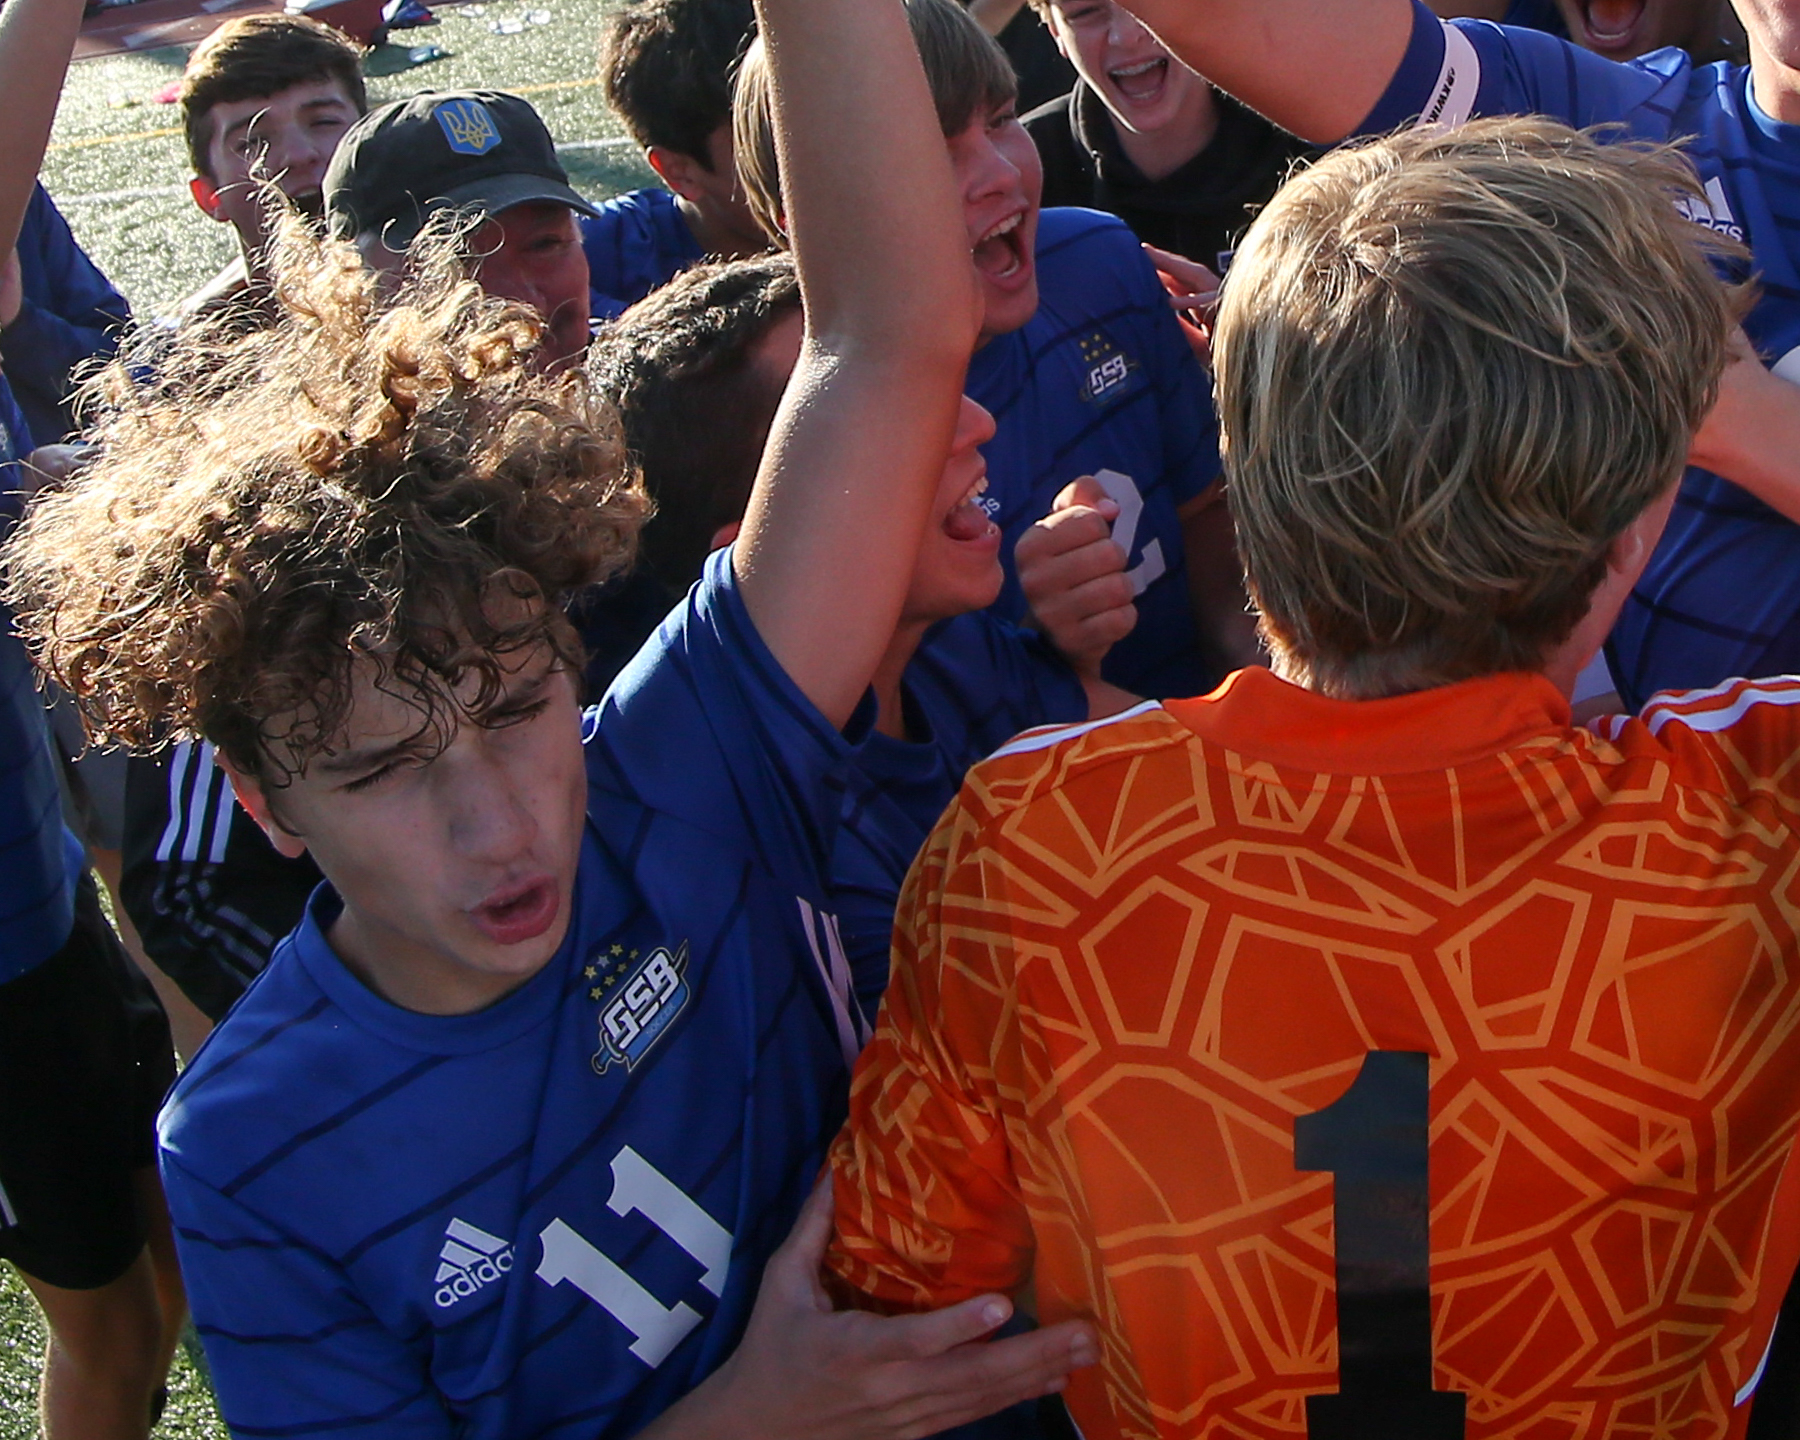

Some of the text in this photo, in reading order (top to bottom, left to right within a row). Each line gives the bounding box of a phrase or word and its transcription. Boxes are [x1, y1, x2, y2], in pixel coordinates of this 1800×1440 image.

[1090, 354, 1127, 395] GSB
[603, 951, 680, 1049] GSB
[434, 1246, 517, 1308] adida
[535, 1144, 734, 1369] 11
[1294, 1050, 1467, 1440] 1
